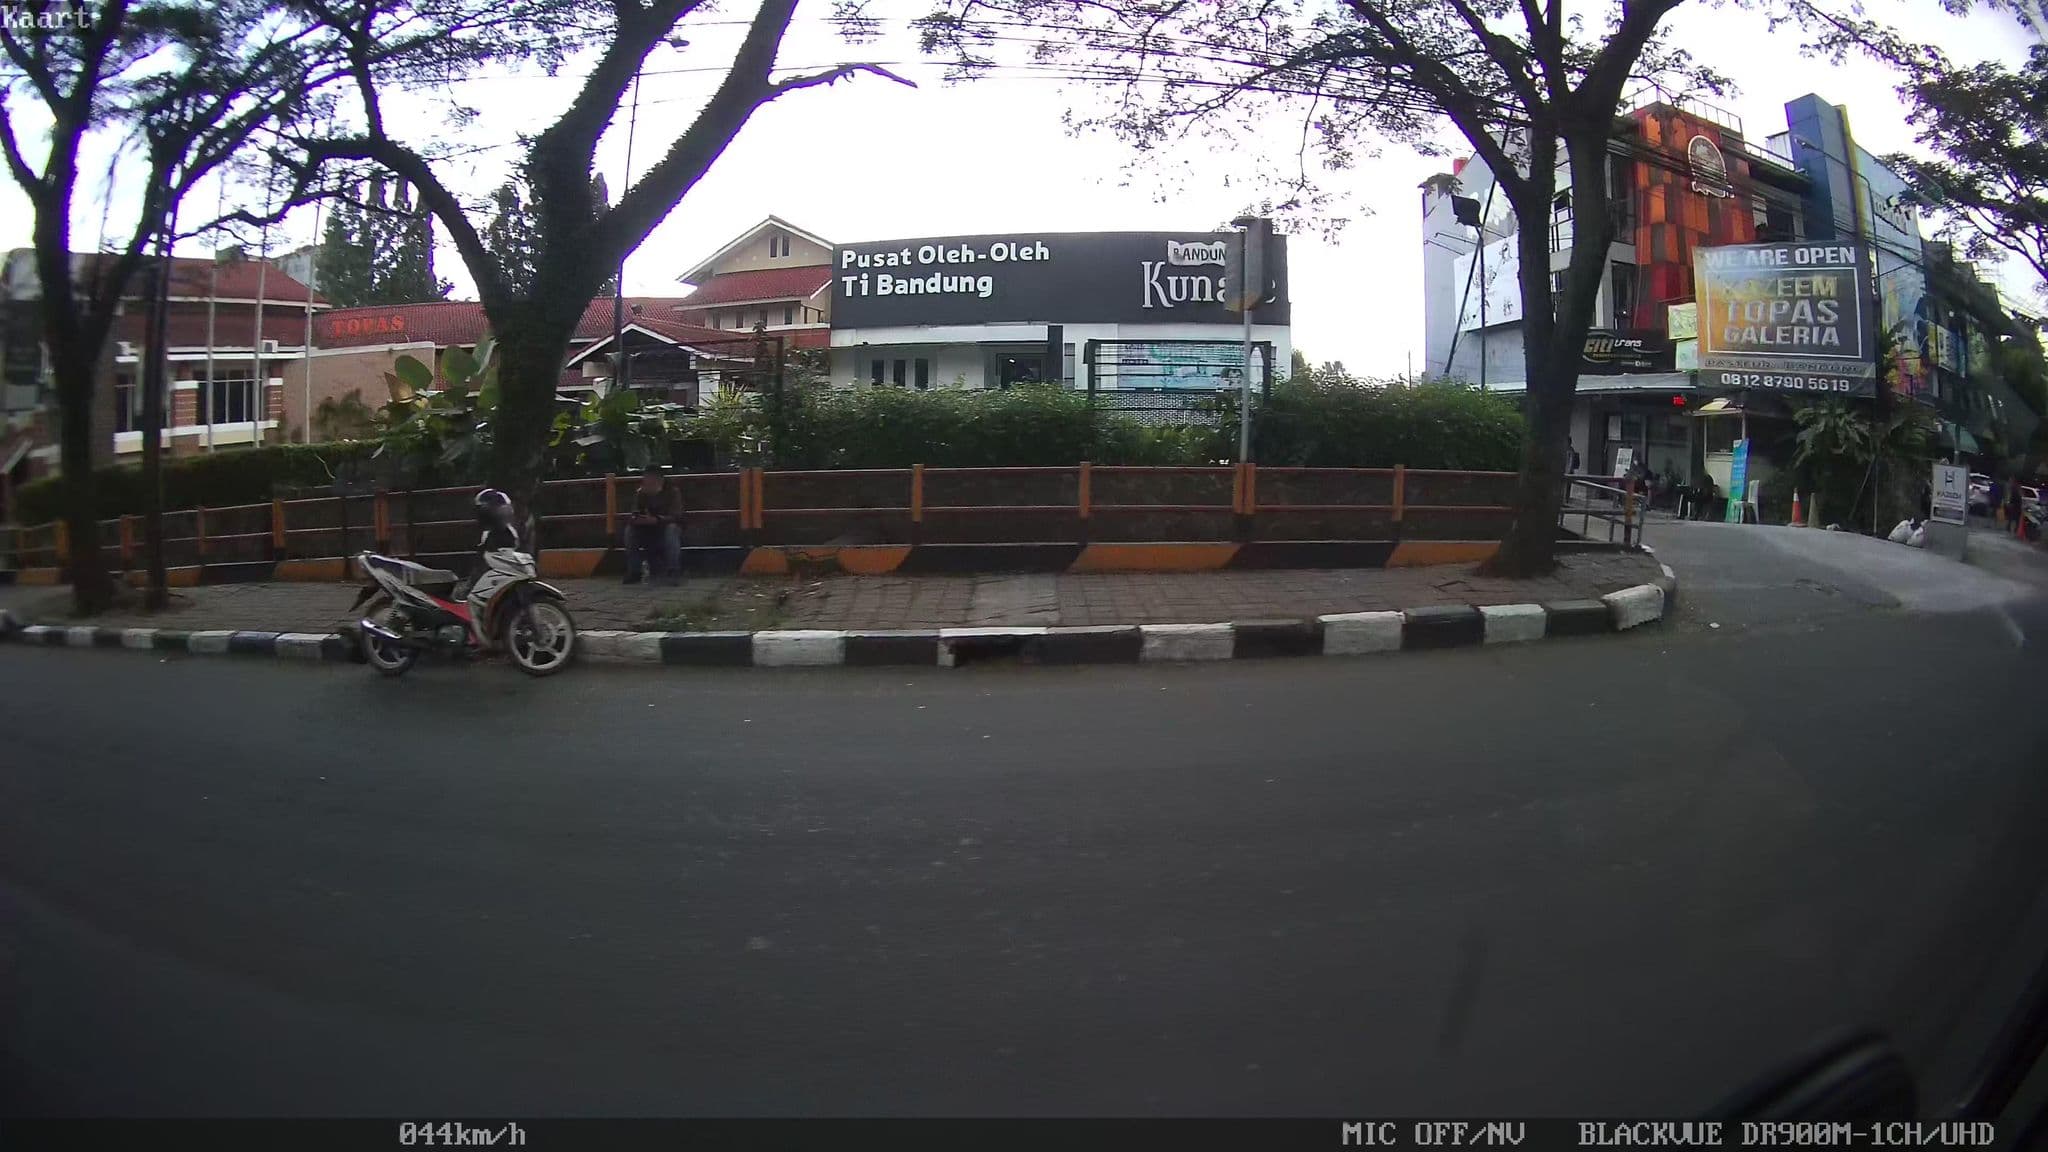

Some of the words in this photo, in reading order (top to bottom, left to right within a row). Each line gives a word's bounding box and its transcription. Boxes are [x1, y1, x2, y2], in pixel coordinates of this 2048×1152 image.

[841, 248, 912, 269] Pusat
[918, 241, 1050, 265] Oleh-Oleh
[1172, 247, 1227, 262] BANDUN
[1745, 249, 1789, 266] ARE
[1795, 246, 1856, 265] OPEN
[841, 273, 869, 297] Ti
[876, 272, 993, 298] Bandung
[1727, 299, 1839, 325] TOPAS
[332, 315, 404, 338] TOPAS
[1723, 326, 1840, 347] GALERIA
[1721, 373, 1760, 386] 0812
[1763, 375, 1804, 389] 8790
[1808, 377, 1850, 392] 5619
